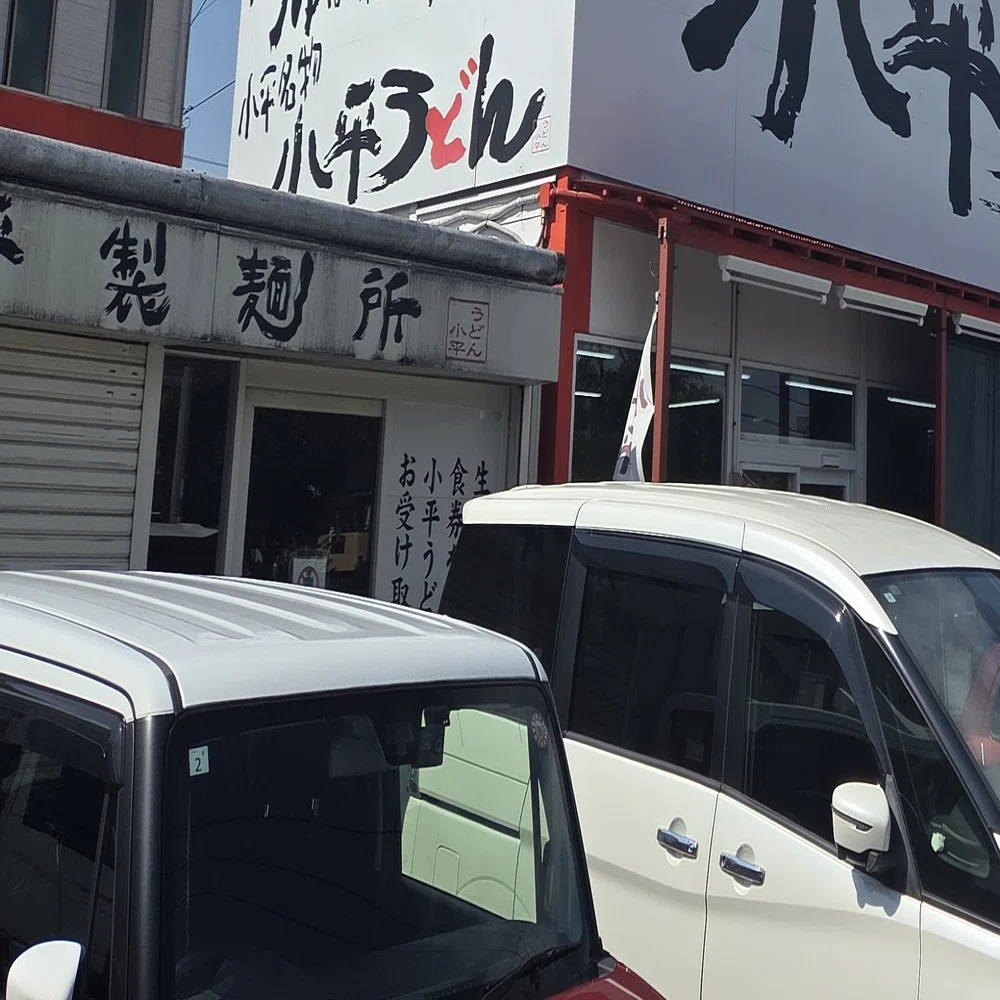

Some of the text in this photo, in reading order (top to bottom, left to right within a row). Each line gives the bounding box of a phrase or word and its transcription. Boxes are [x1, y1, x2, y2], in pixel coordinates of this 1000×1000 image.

[271, 33, 545, 204] 小平うどん
[448, 322, 467, 356] 小平
[468, 306, 485, 357] うどん
[194, 757, 202, 773] 2
